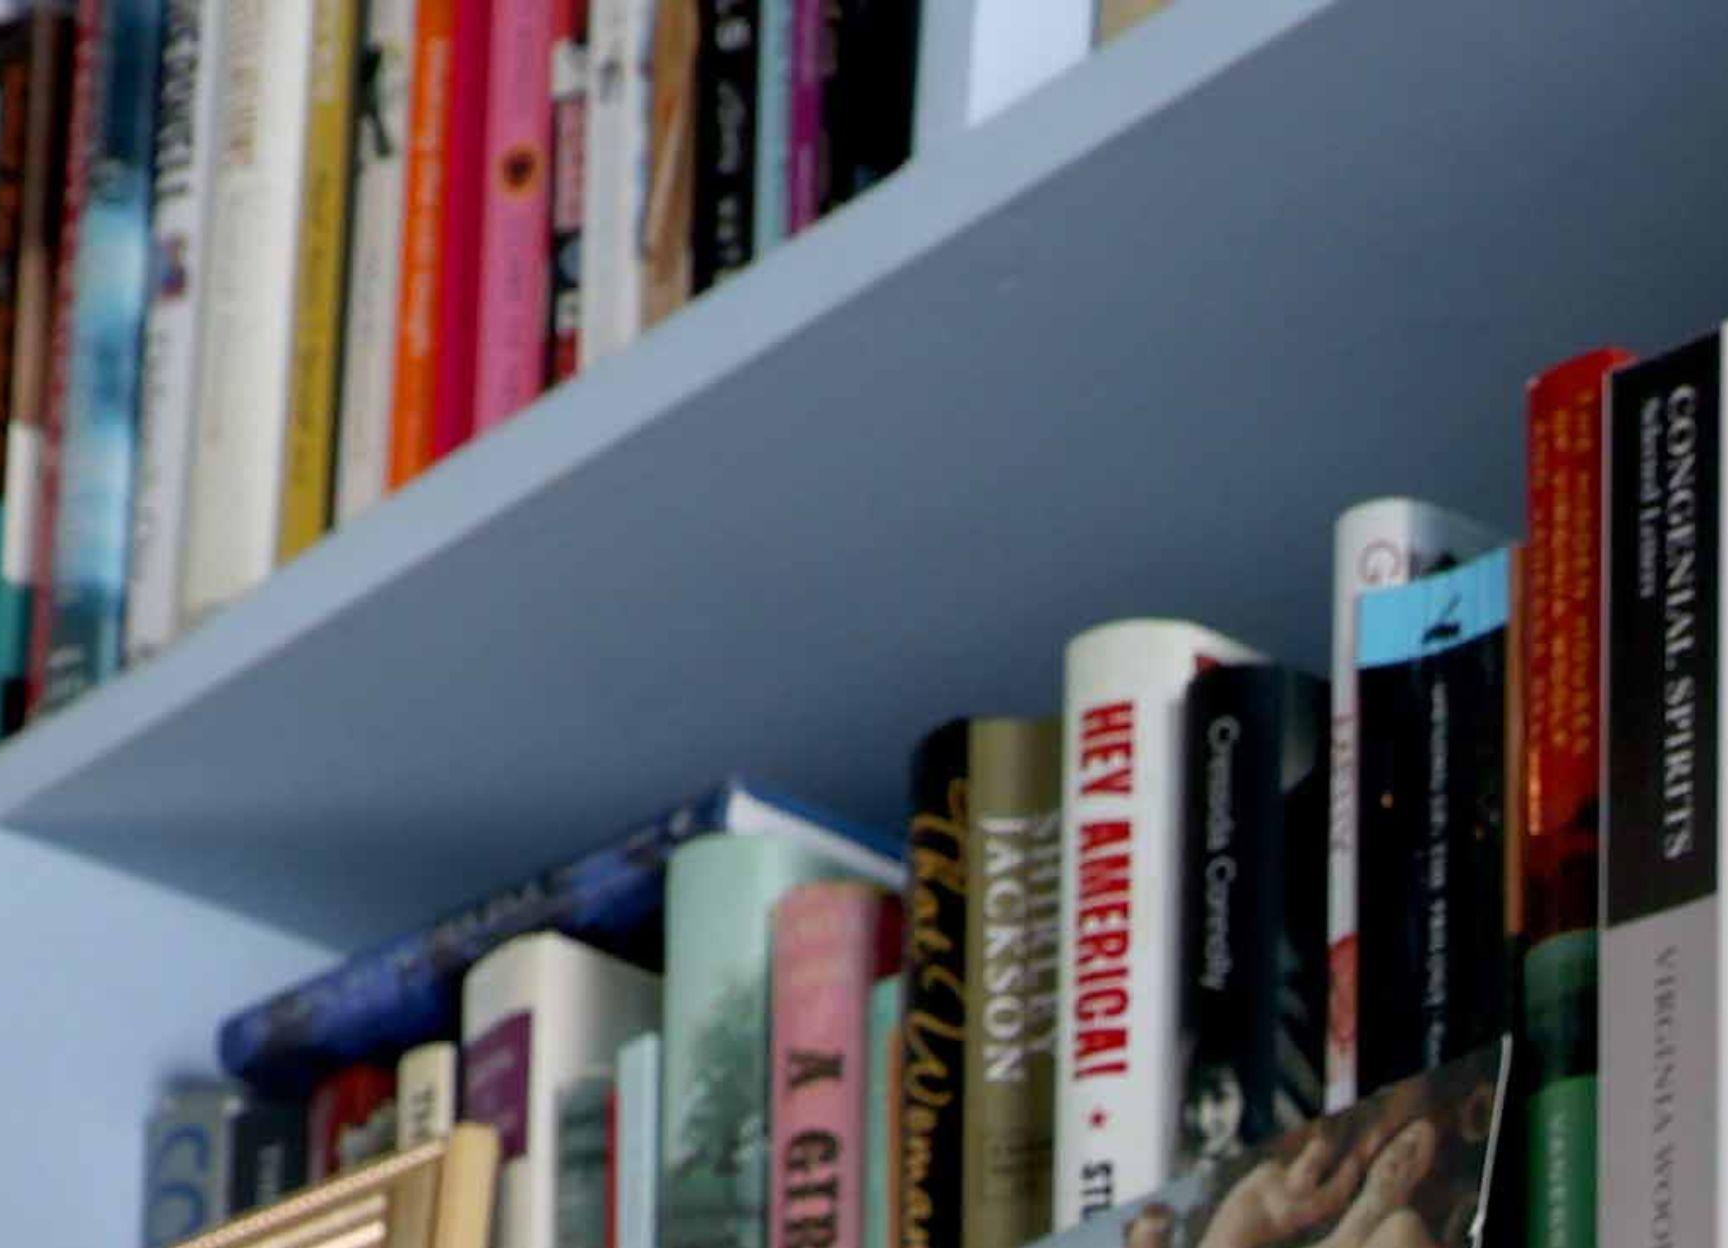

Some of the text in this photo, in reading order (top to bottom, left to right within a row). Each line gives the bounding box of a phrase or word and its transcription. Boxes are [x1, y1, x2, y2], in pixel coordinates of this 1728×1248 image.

[1080, 699, 1135, 795] HEY
[1663, 384, 1697, 860] CONGENIAL SPIRITS
[978, 816, 1027, 1083] JACKSON
[1075, 818, 1133, 1083] AMERICA!
[1653, 946, 1678, 1133] VIRGINIA
